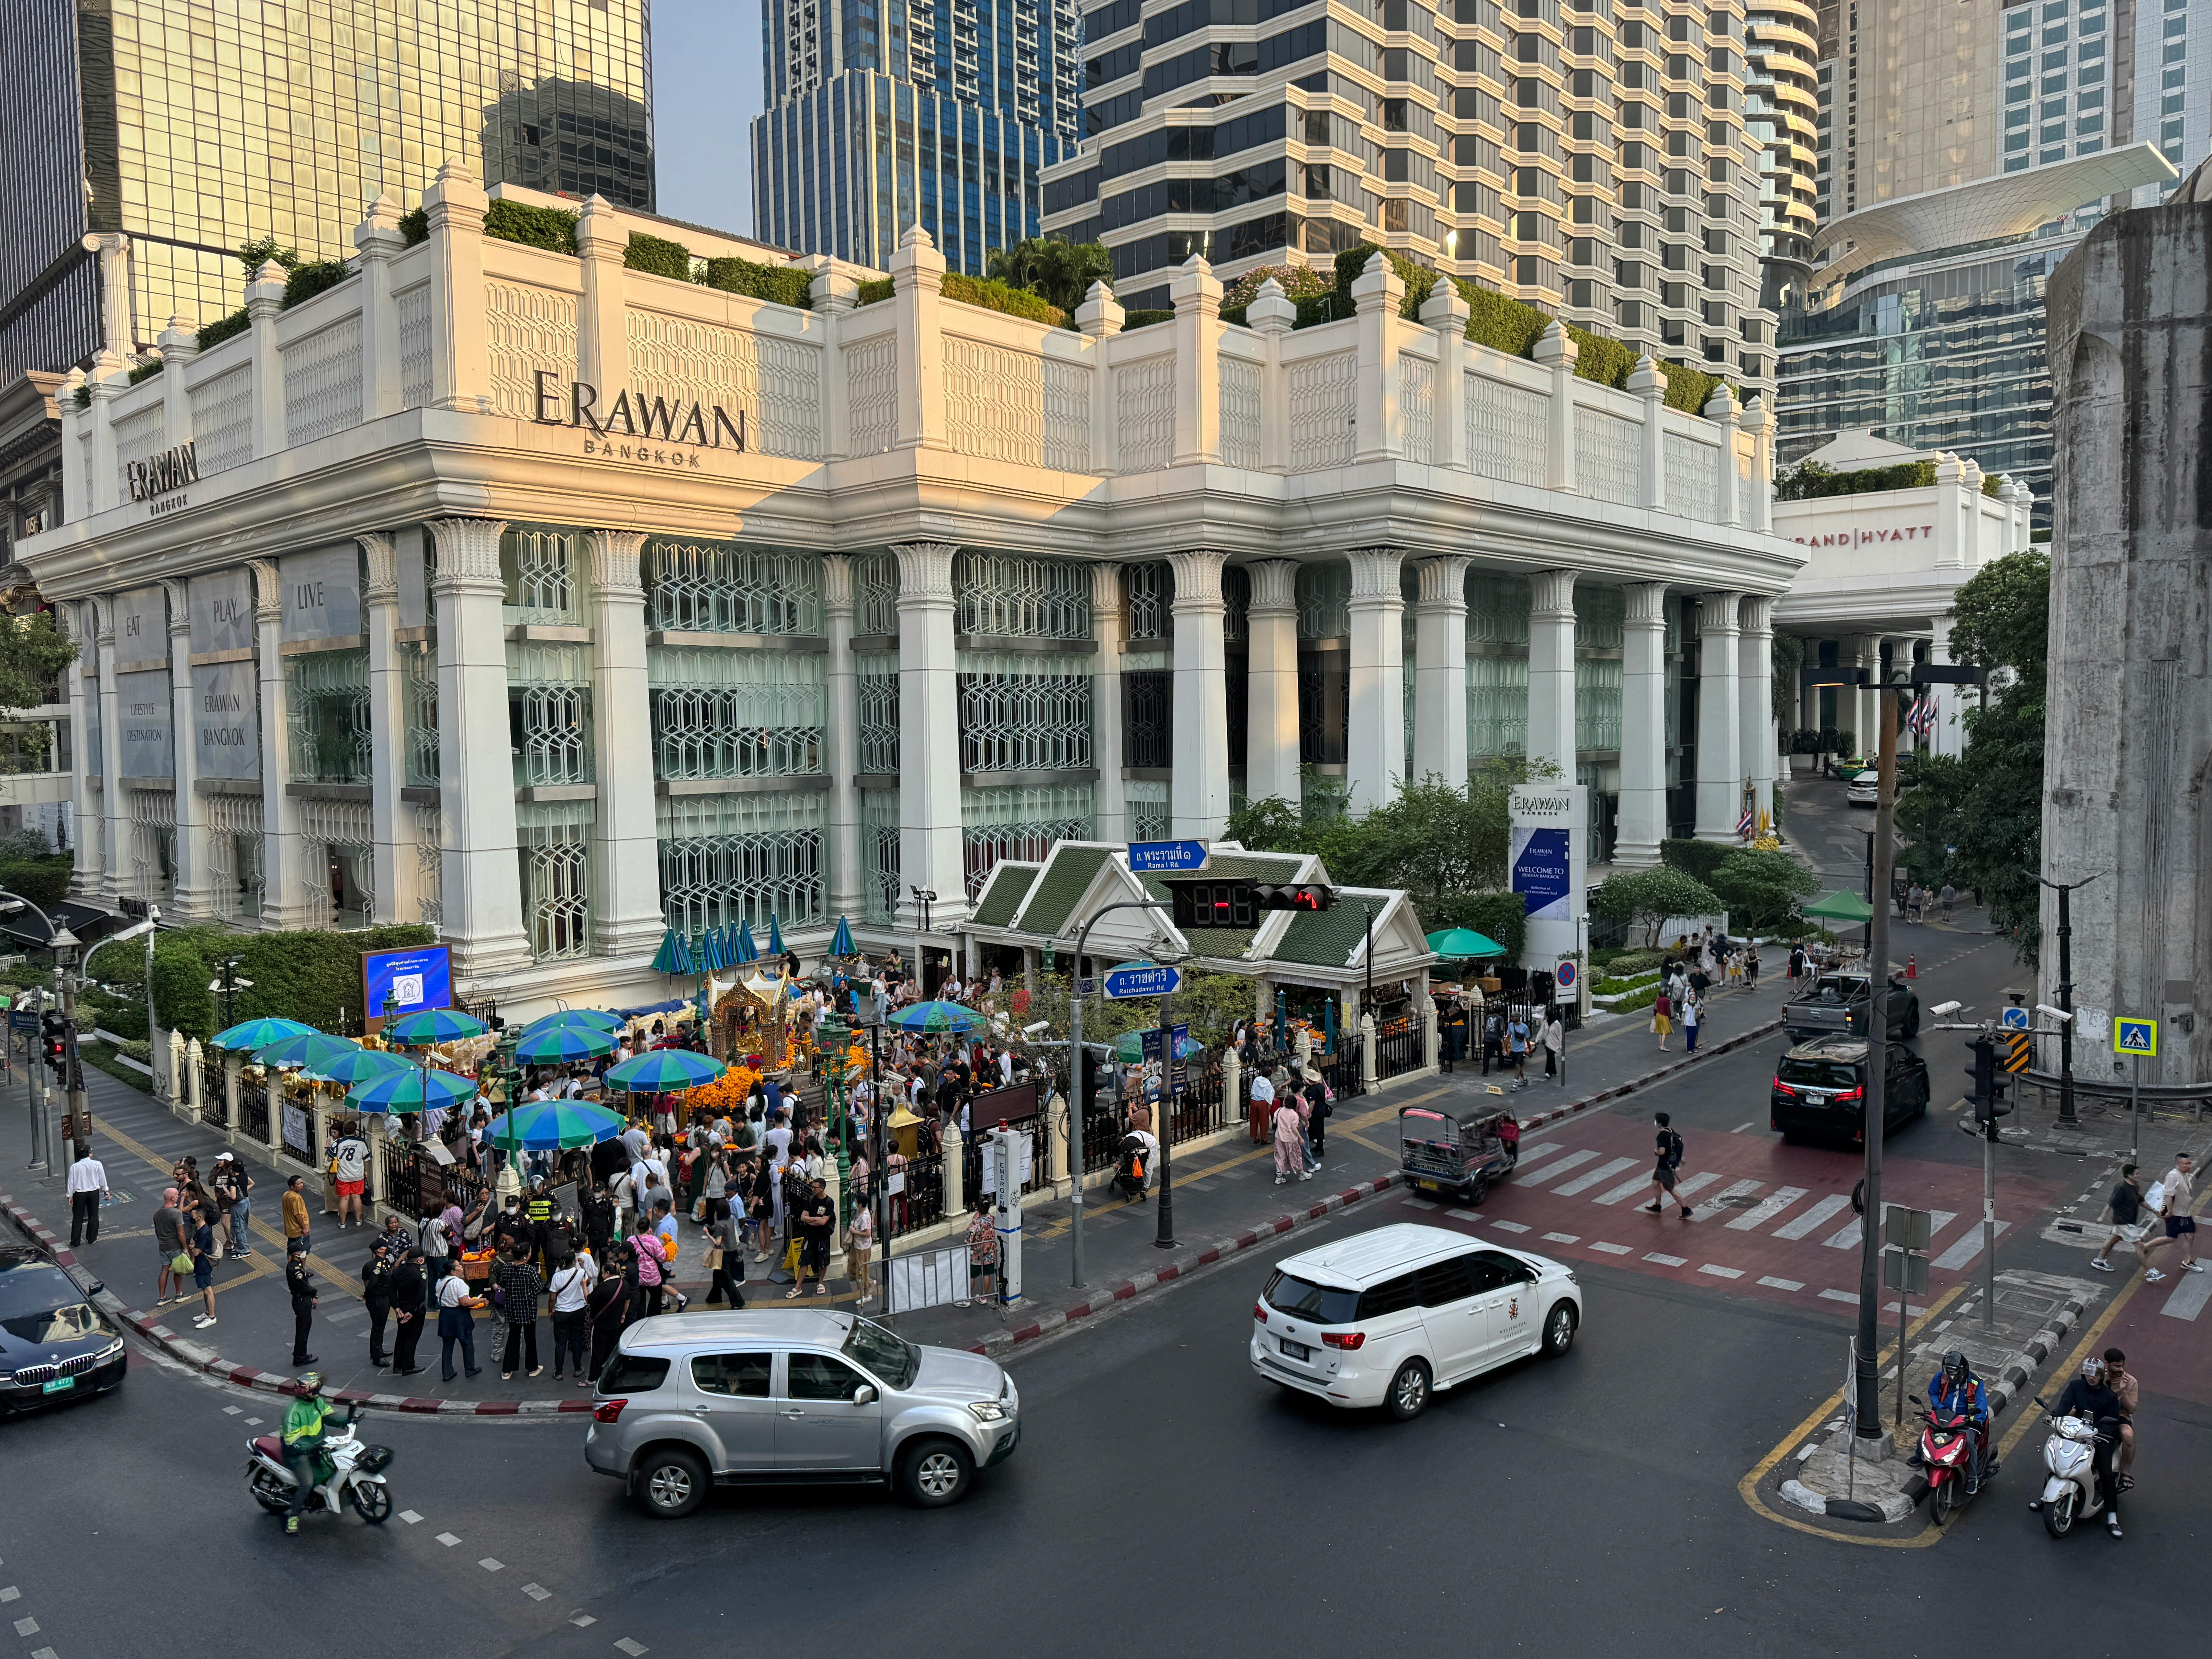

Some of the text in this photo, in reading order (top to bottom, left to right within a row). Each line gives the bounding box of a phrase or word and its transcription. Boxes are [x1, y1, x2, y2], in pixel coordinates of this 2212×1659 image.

[531, 370, 745, 452] ERAWAN
[584, 440, 700, 468] BANGKOK
[127, 442, 198, 501] ERAWAN
[150, 494, 188, 516] BANGKOK
[1787, 526, 1932, 548] RAND HYATT
[297, 582, 323, 610] LIVE
[213, 598, 238, 623] PLAY
[127, 615, 140, 637] EAT
[131, 702, 155, 716] LIFESTYLE
[204, 694, 240, 713] ERAWAN
[127, 729, 161, 742] DESTINATION
[204, 728, 245, 746] BANGKOK
[1513, 796, 1569, 811] ERAWAN
[1518, 866, 1553, 874] WELCOME
[1119, 986, 1154, 994] Ratchadamri
[339, 1147, 356, 1162] 78
